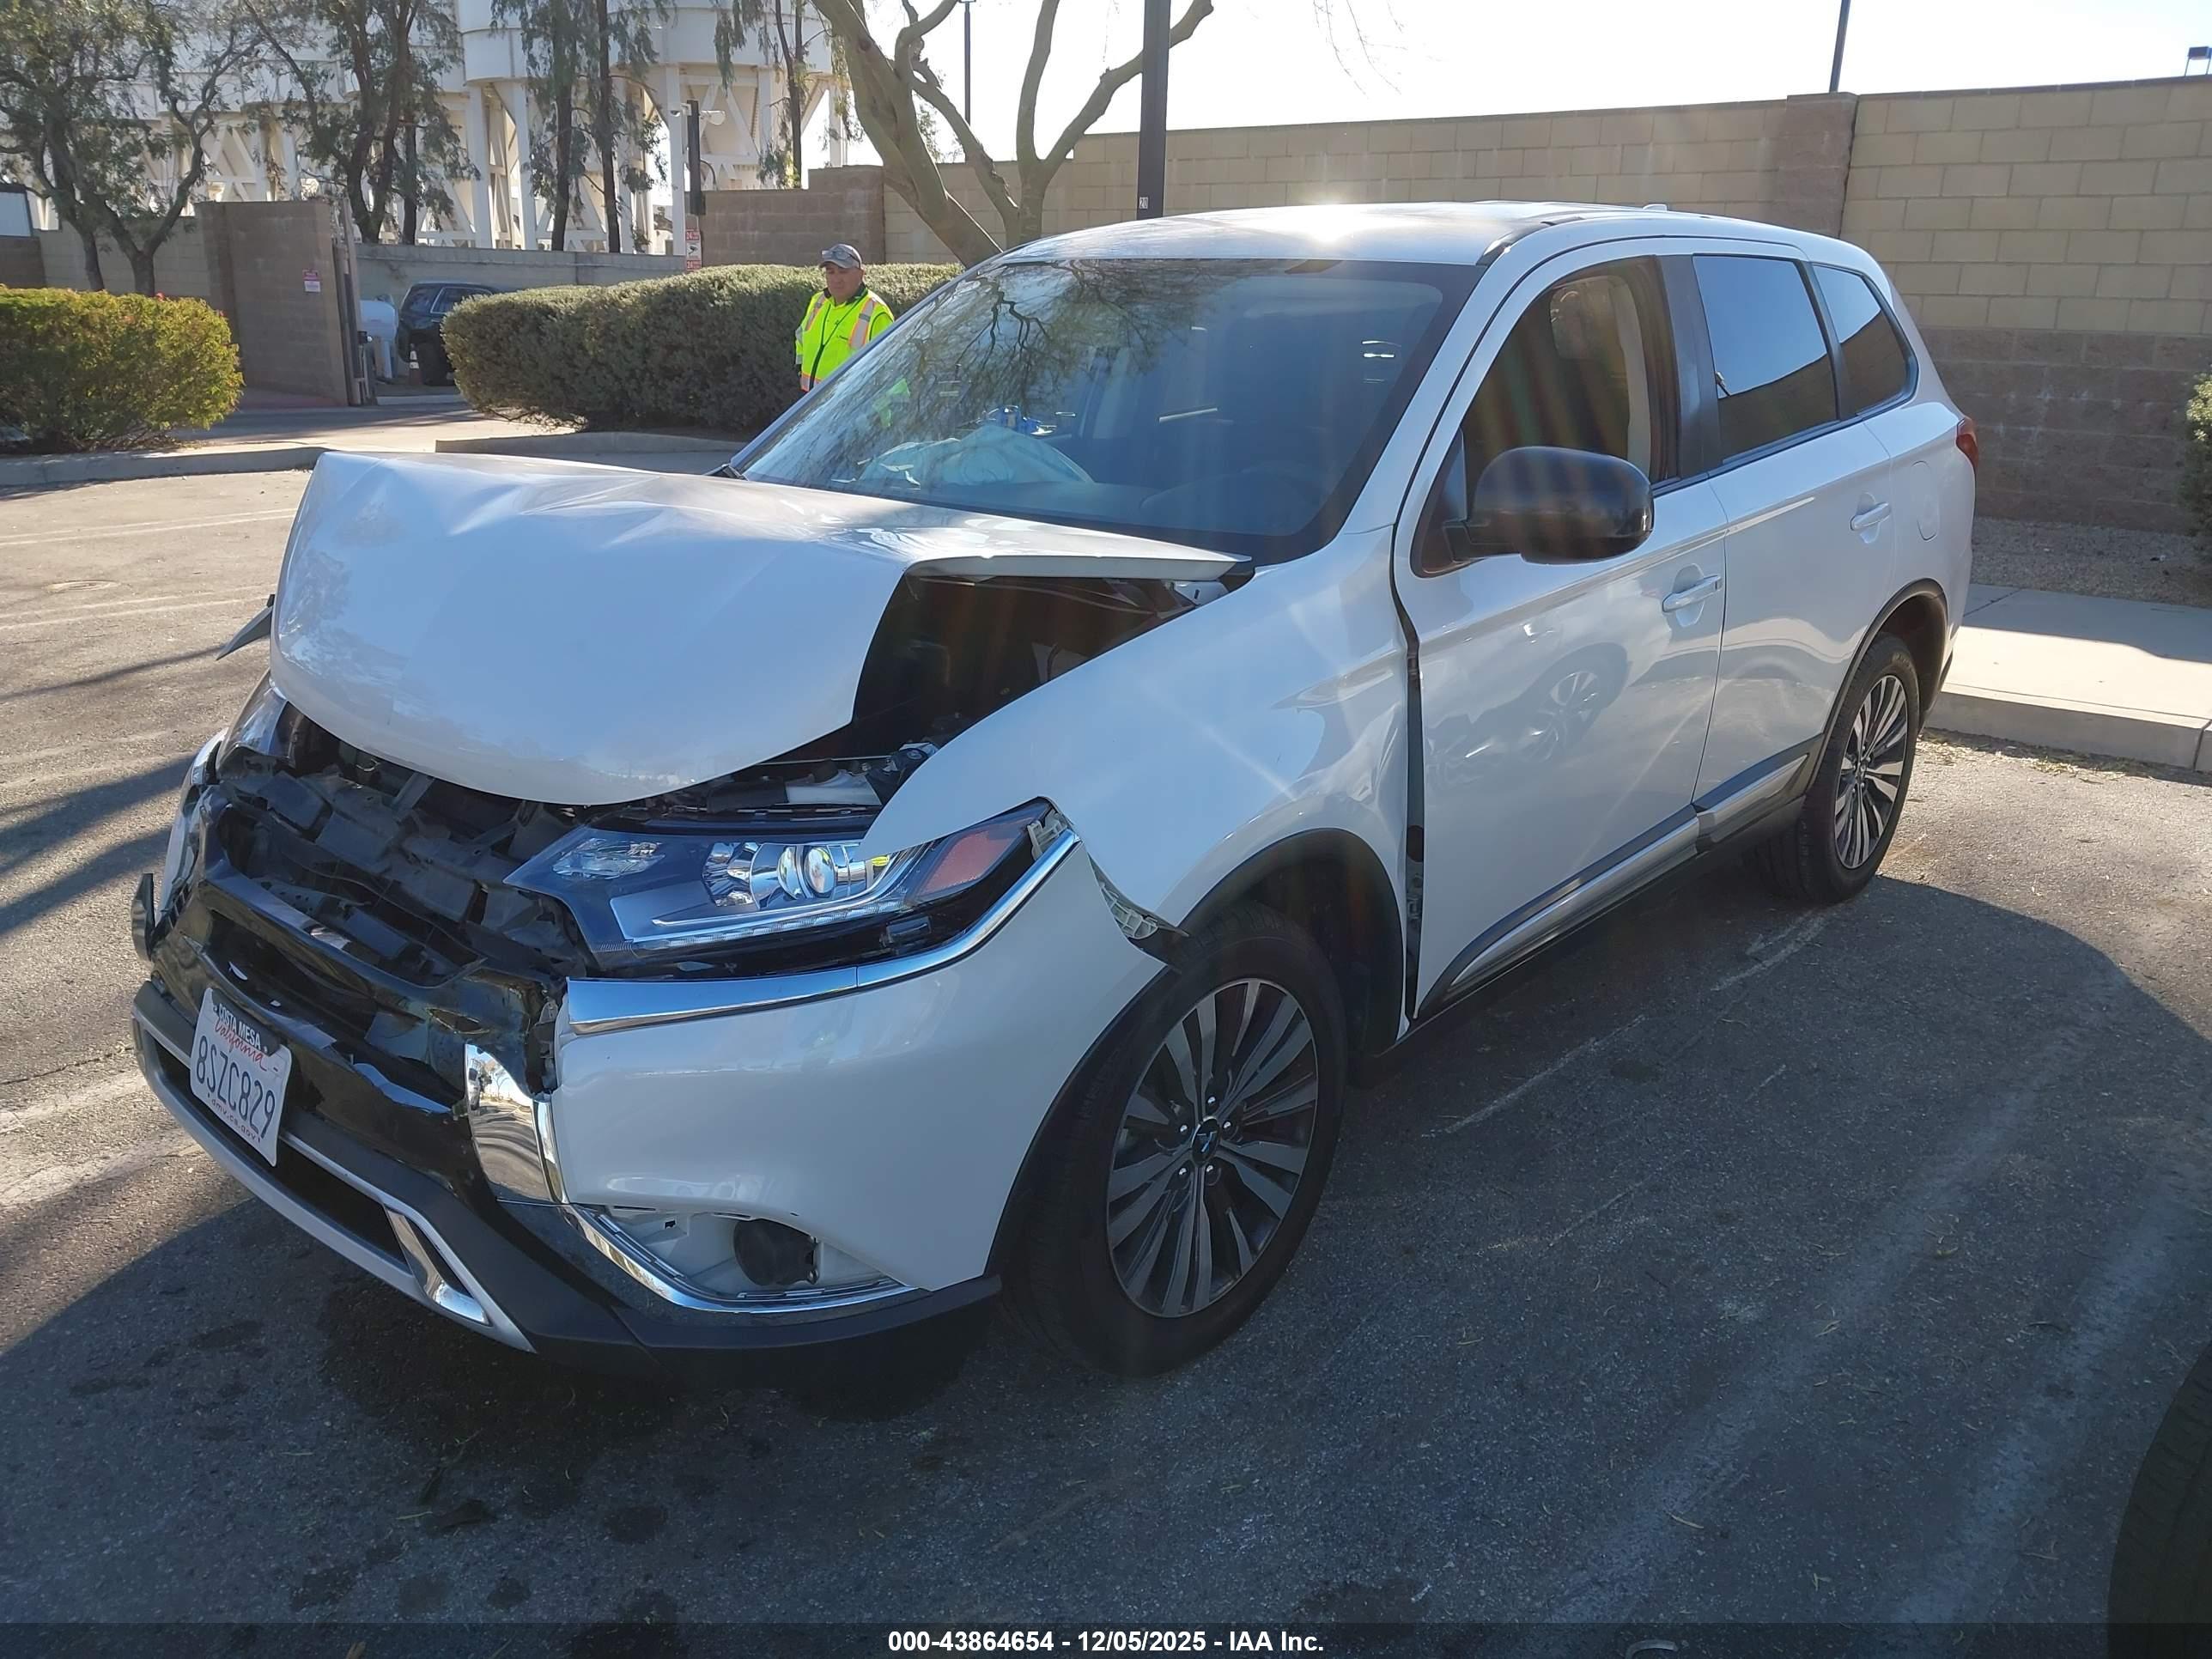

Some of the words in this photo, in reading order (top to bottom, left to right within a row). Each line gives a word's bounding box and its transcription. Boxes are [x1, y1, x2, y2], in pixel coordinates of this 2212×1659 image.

[214, 1018, 267, 1072] California
[218, 1003, 238, 1033] COSTA
[238, 1020, 261, 1051] MESA
[197, 1035, 276, 1139] 8SZC829
